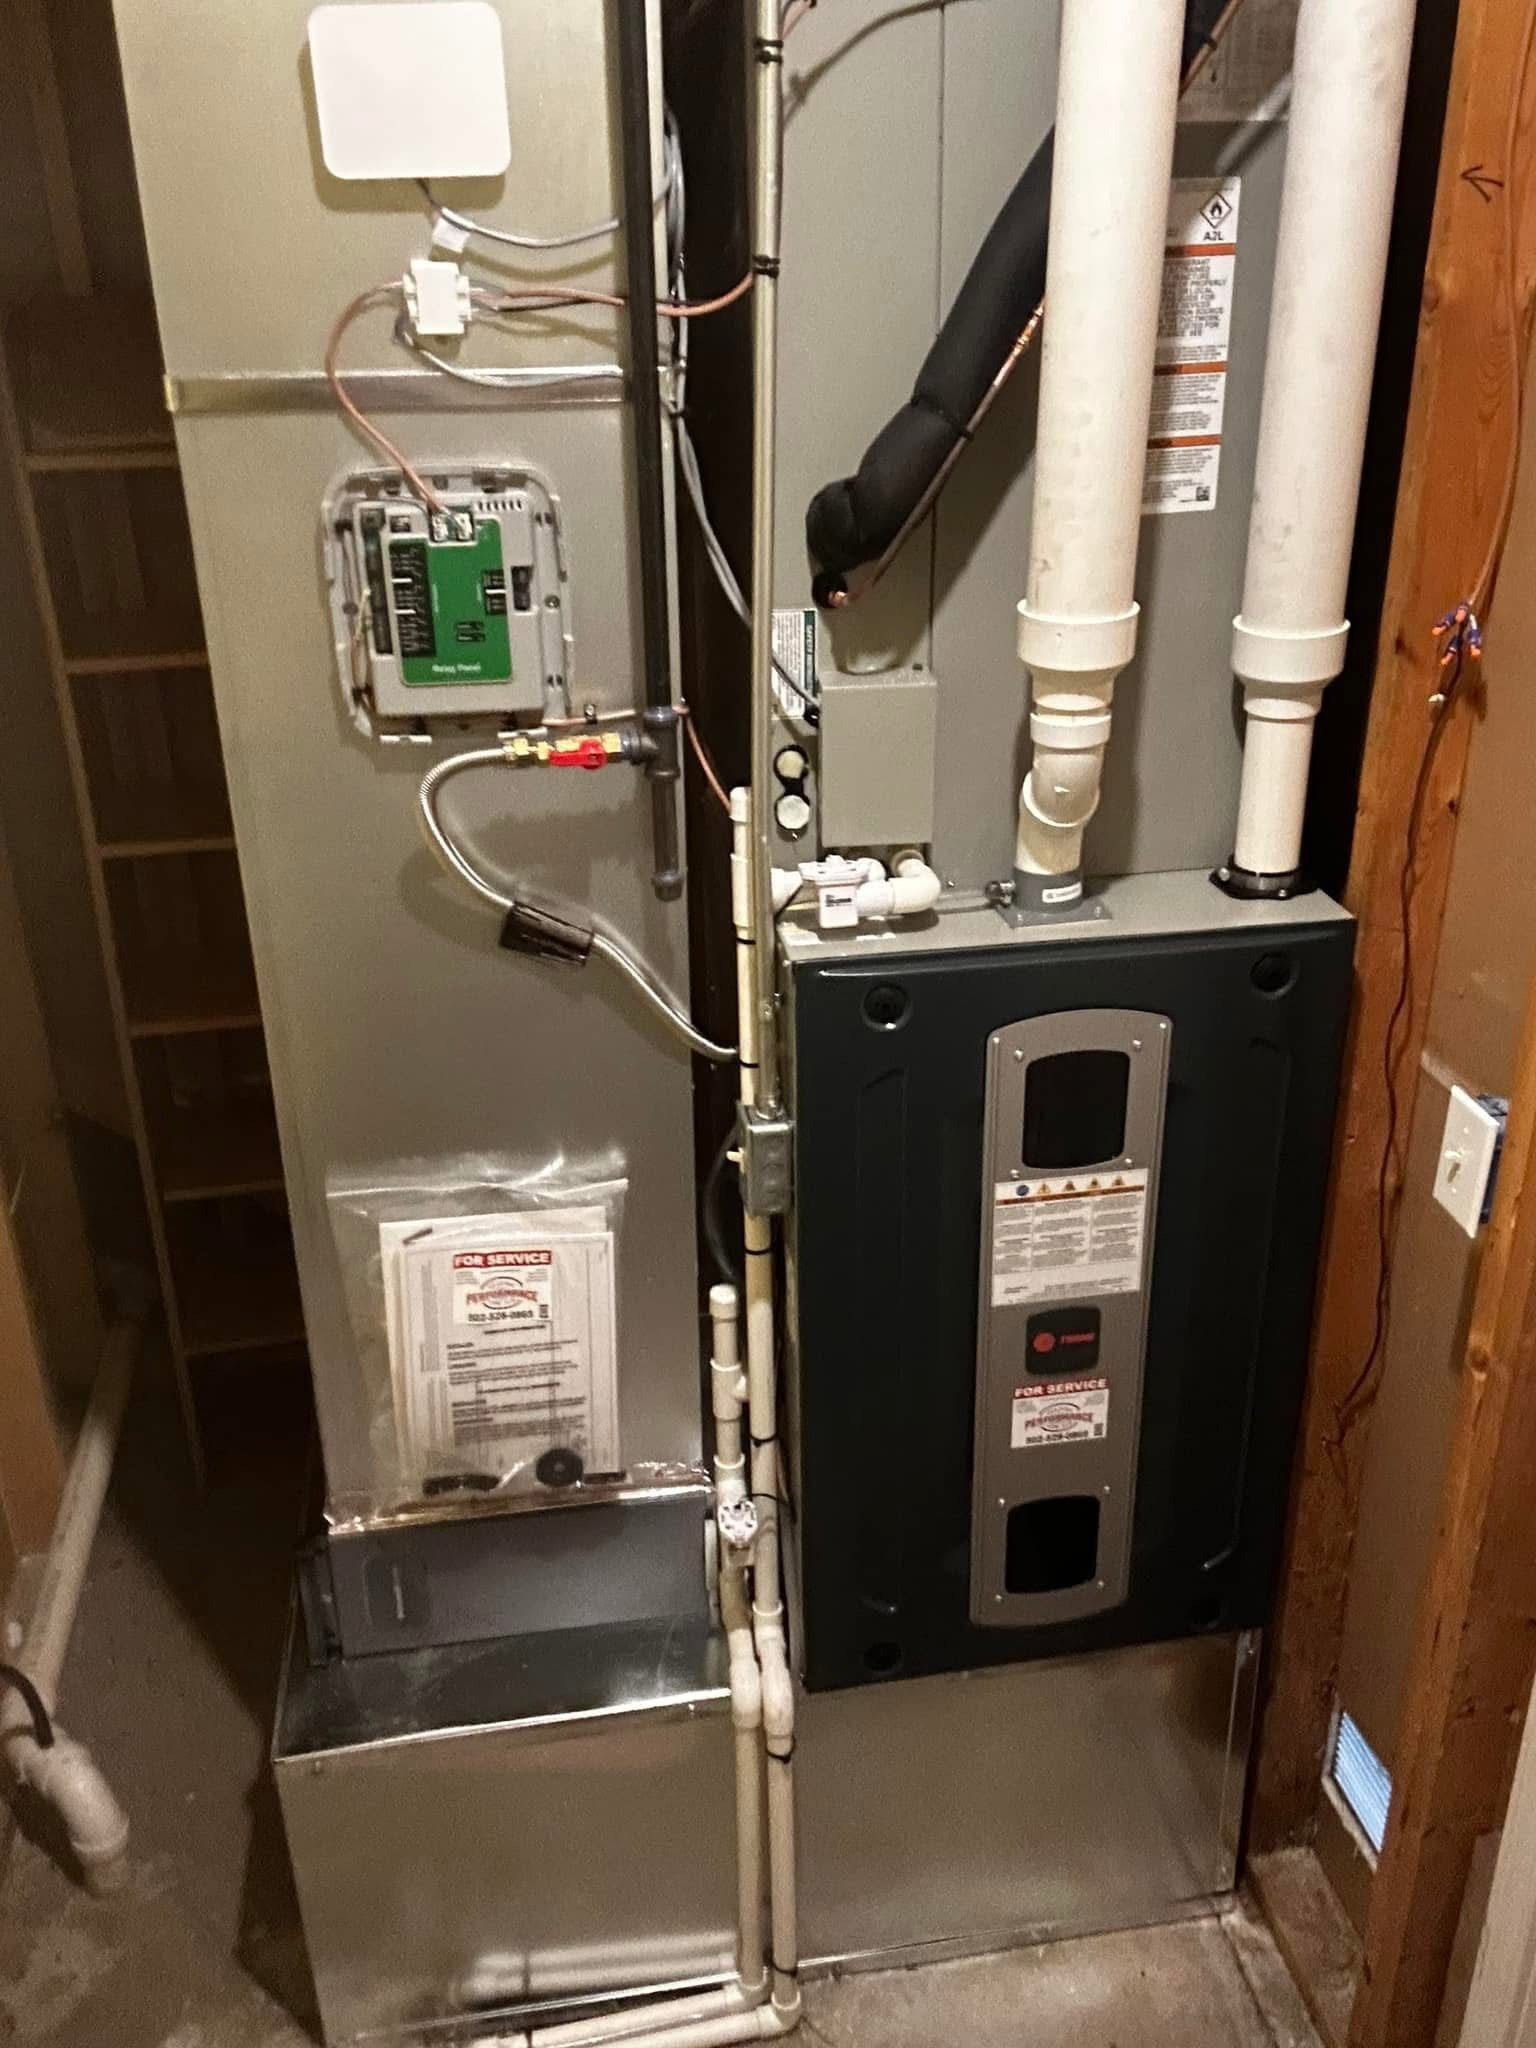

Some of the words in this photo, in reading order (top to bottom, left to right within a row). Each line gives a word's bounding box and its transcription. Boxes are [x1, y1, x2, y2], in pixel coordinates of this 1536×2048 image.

[1203, 231, 1224, 241] A2L
[455, 1253, 483, 1267] FOR
[487, 1252, 550, 1265] SERVICE
[1015, 1385, 1043, 1398] FOR
[1046, 1378, 1107, 1394] SERVICE
